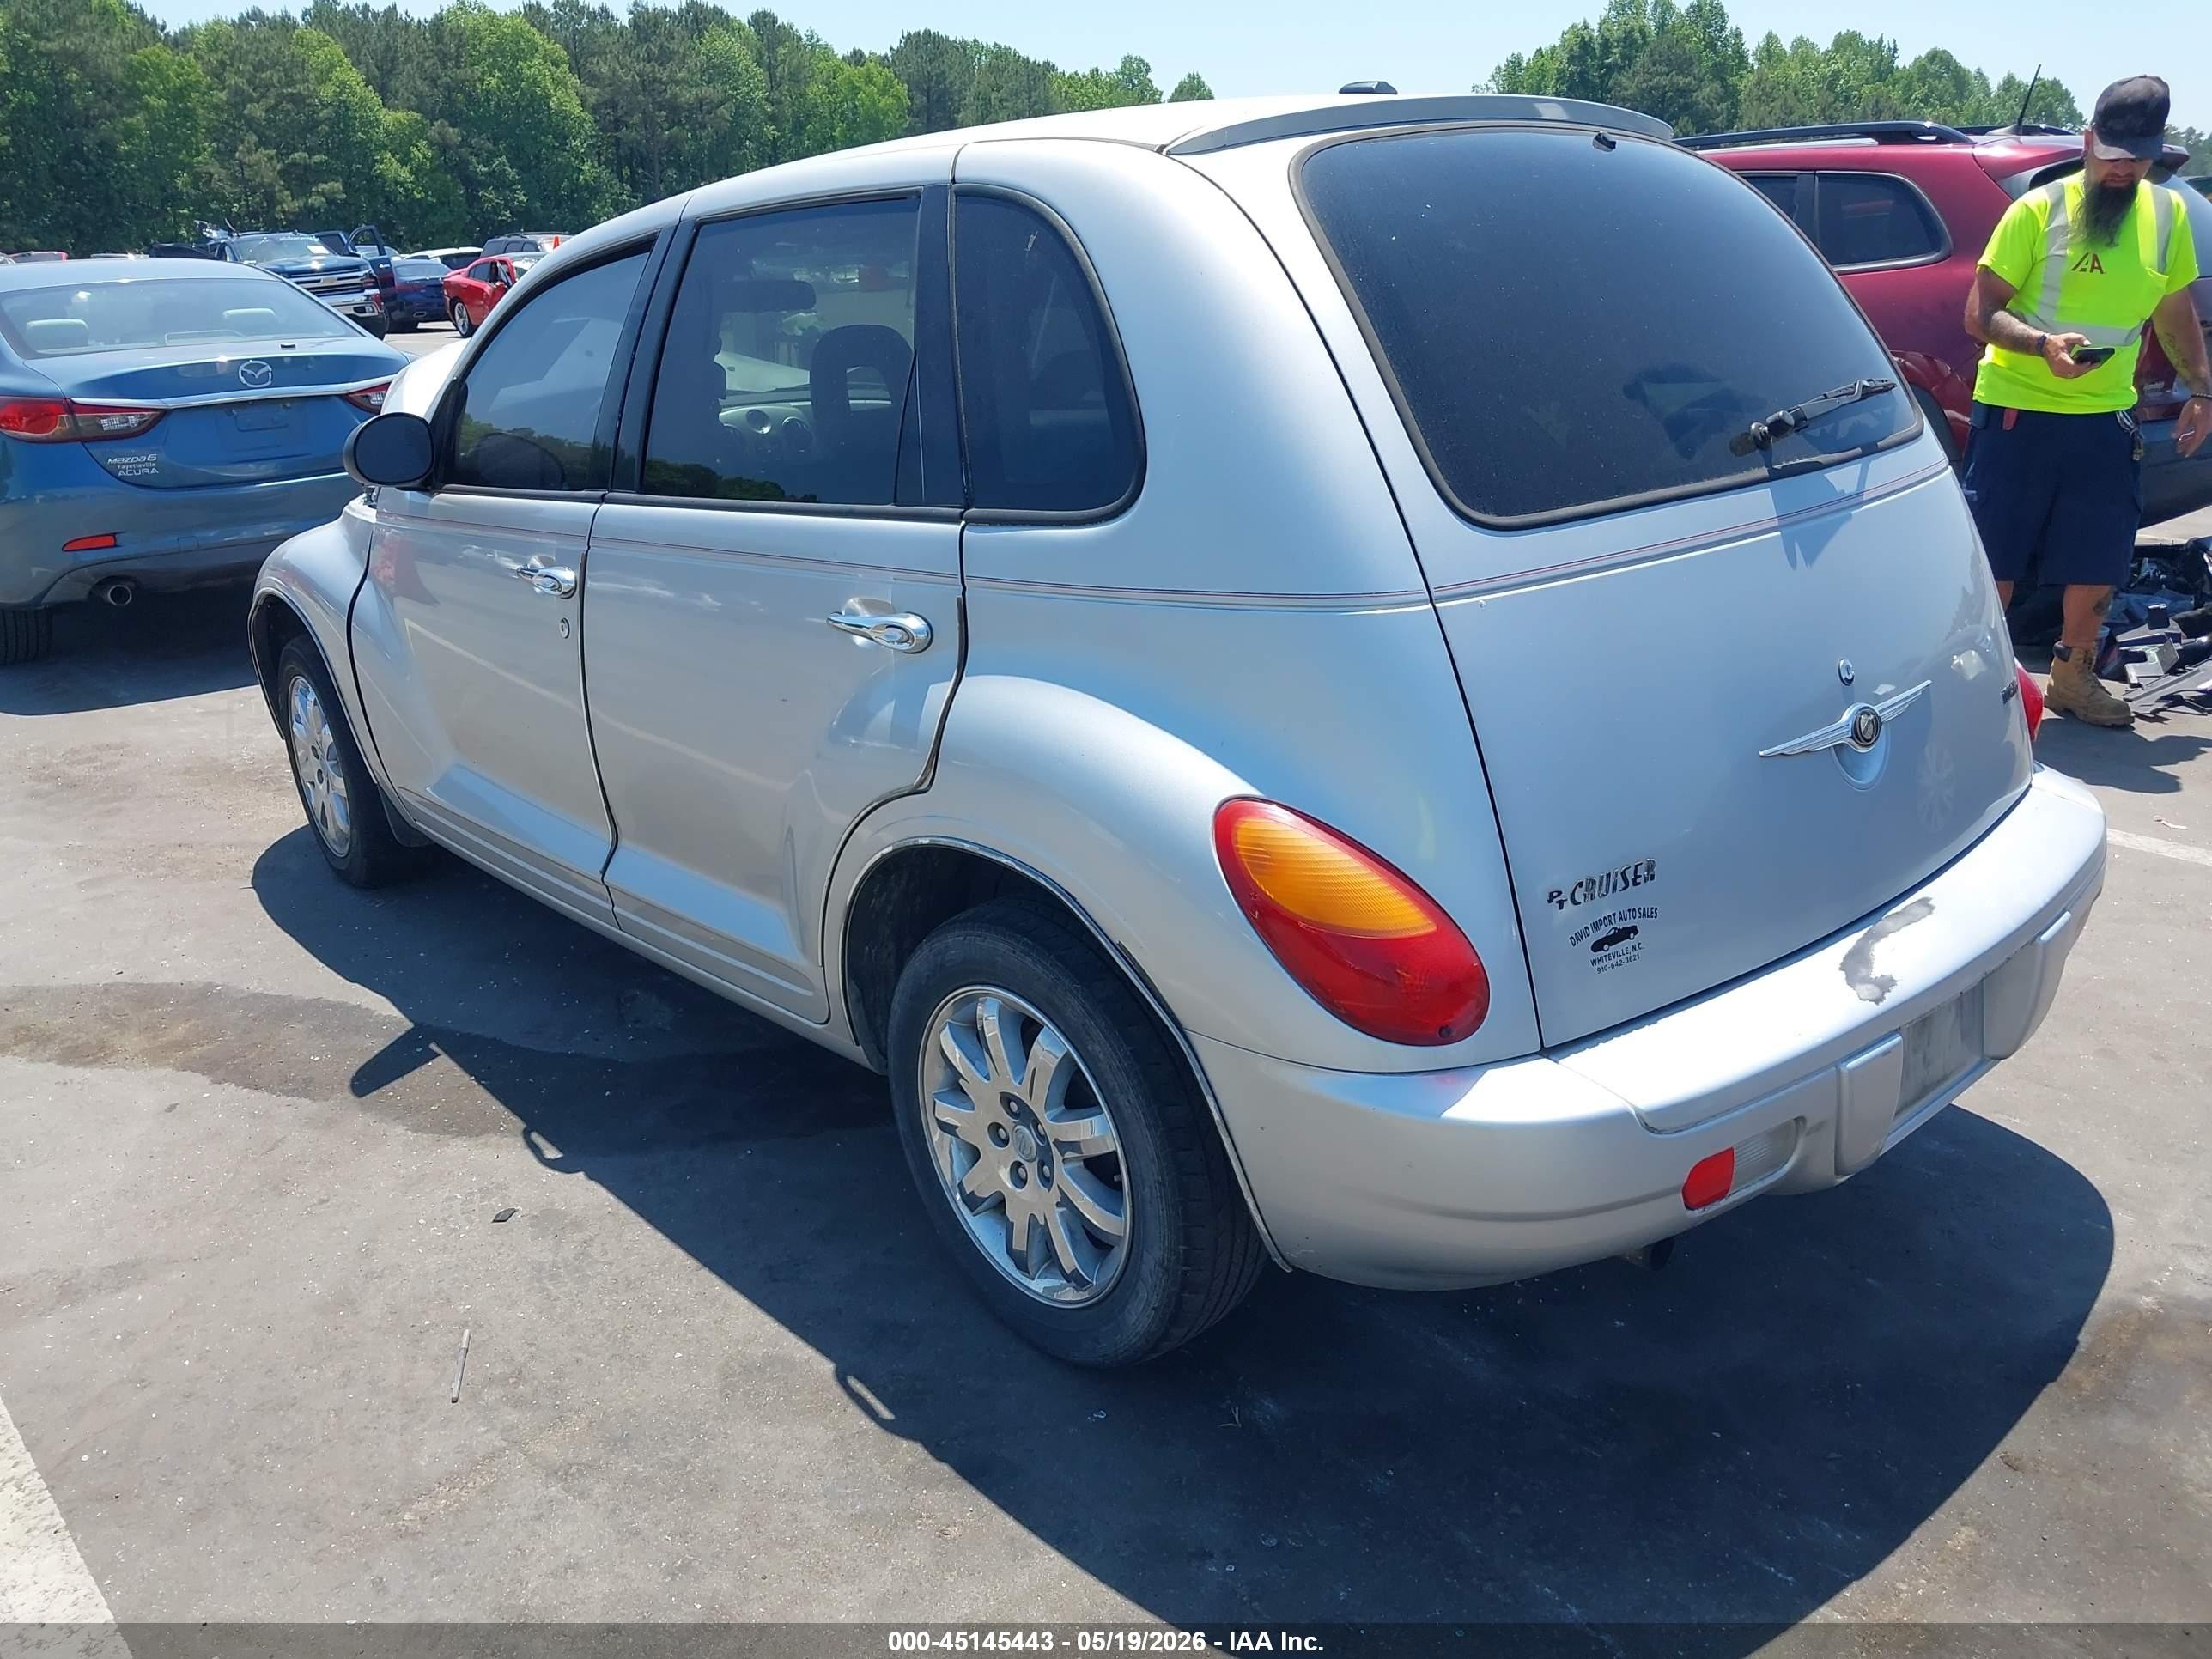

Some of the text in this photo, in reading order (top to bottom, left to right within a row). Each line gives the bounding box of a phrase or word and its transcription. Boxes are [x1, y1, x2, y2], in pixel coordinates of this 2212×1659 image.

[1570, 858, 1656, 906] CRUISER
[1569, 907, 1658, 947] DAVID IMPORT AUTO SALES
